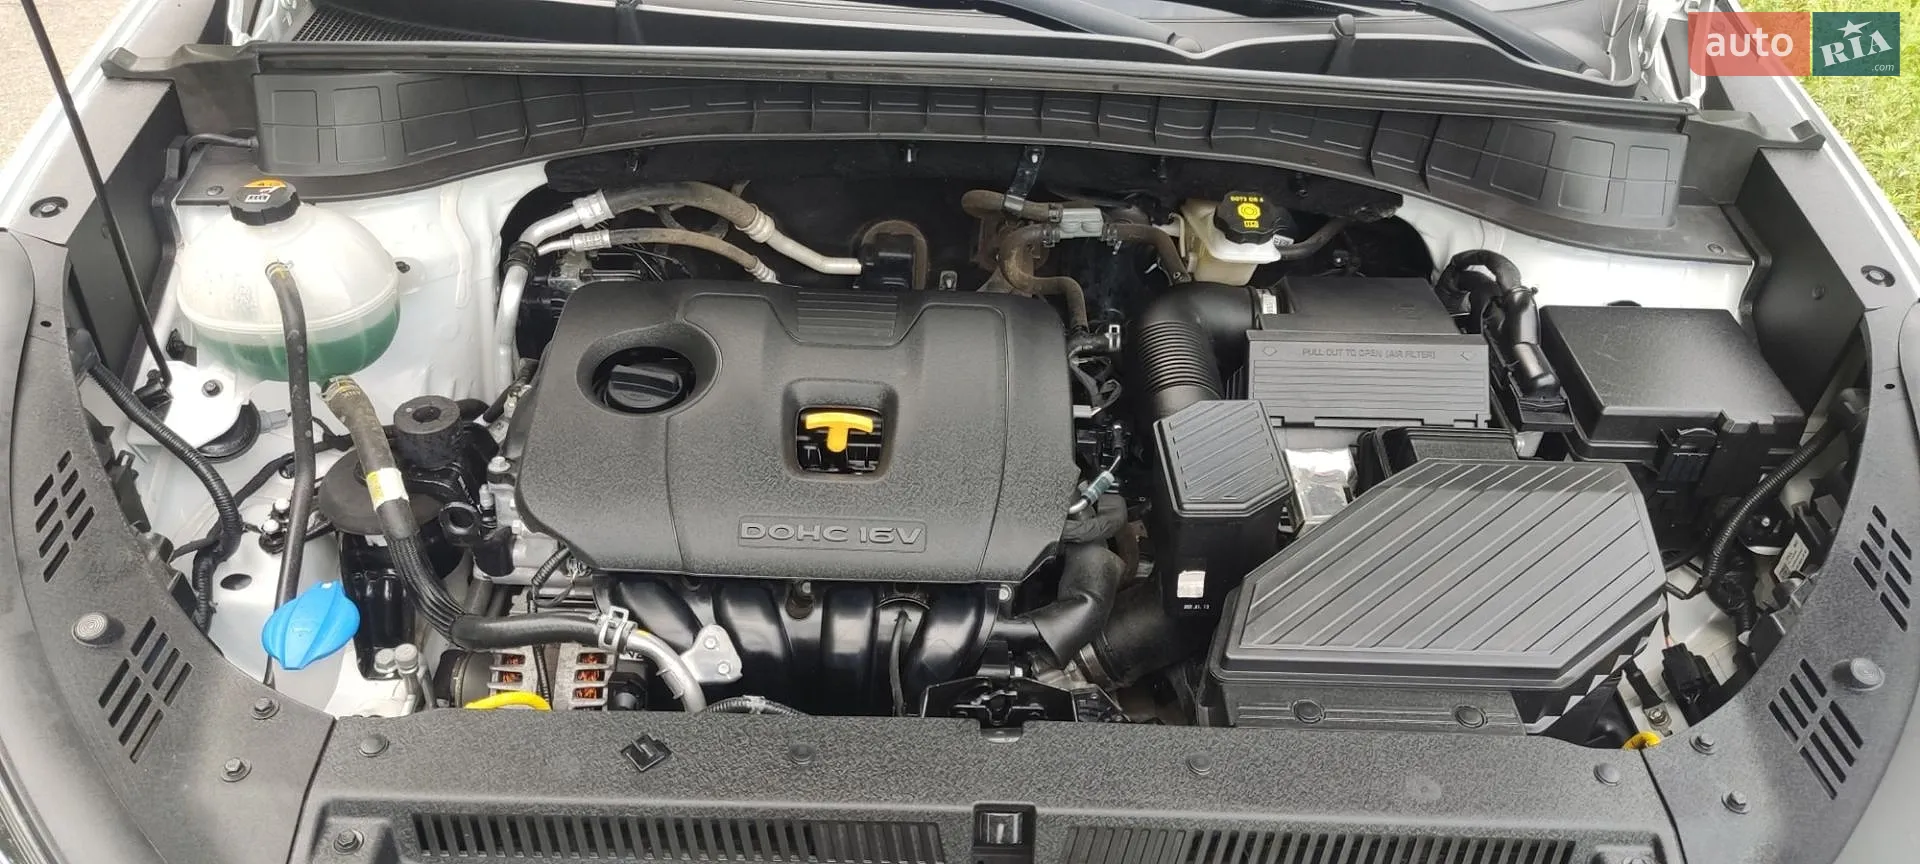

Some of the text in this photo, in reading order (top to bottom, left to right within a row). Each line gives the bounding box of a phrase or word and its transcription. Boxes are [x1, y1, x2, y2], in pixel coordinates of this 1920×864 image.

[1302, 348, 1324, 357] PULL
[1326, 348, 1343, 357] OUT
[1345, 348, 1357, 357] TO
[1359, 349, 1382, 358] OPEN
[740, 522, 922, 545] DOHC 16V
